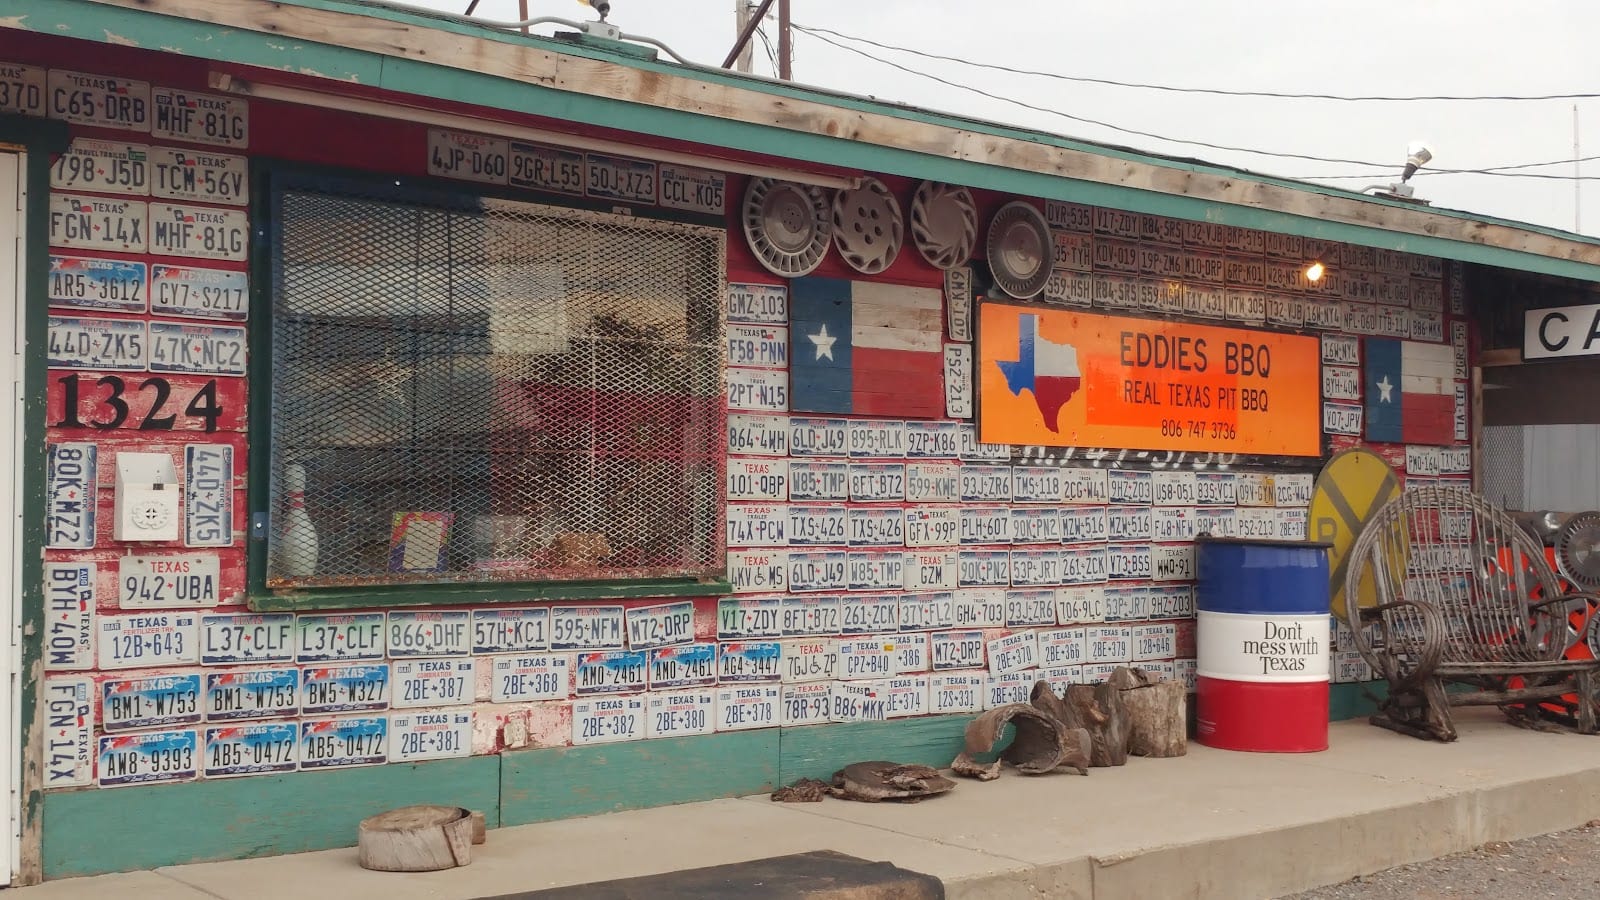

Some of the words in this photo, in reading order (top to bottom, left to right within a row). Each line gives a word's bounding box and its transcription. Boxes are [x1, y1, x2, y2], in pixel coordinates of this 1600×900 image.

[73, 77, 105, 90] TEXAS
[196, 98, 226, 111] TEXAS
[196, 156, 226, 168] TEXAS
[93, 202, 124, 214] TEXAS
[194, 212, 224, 224] TEXAS
[80, 261, 114, 270] TEXAS
[740, 329, 760, 337] TEXAS
[1120, 331, 1208, 373] EDDIES
[1226, 342, 1270, 378] BBQ
[1124, 380, 1160, 406] REAL
[1168, 384, 1210, 408] TEXAS
[1219, 387, 1236, 410] PIT
[1242, 388, 1268, 412] BBQ
[57, 373, 224, 434] 1324
[1162, 420, 1182, 438] 806
[1188, 421, 1206, 438] 747
[1212, 422, 1236, 440] 3736
[744, 464, 770, 474] TEXAS
[150, 562, 190, 572] TEXAS
[129, 617, 168, 628] TEXAS
[80, 613, 90, 645] TEXAS
[1264, 622, 1302, 640] Don't
[1244, 640, 1286, 655] mess
[1290, 637, 1318, 654] with
[419, 662, 451, 671] TEXAS
[517, 658, 546, 667] TEXAS
[1260, 657, 1304, 674] Texas
[132, 678, 174, 690] TEXAS
[234, 672, 274, 684] TEXAS
[668, 696, 694, 704] TEXAS
[78, 728, 88, 760] TEXAS
